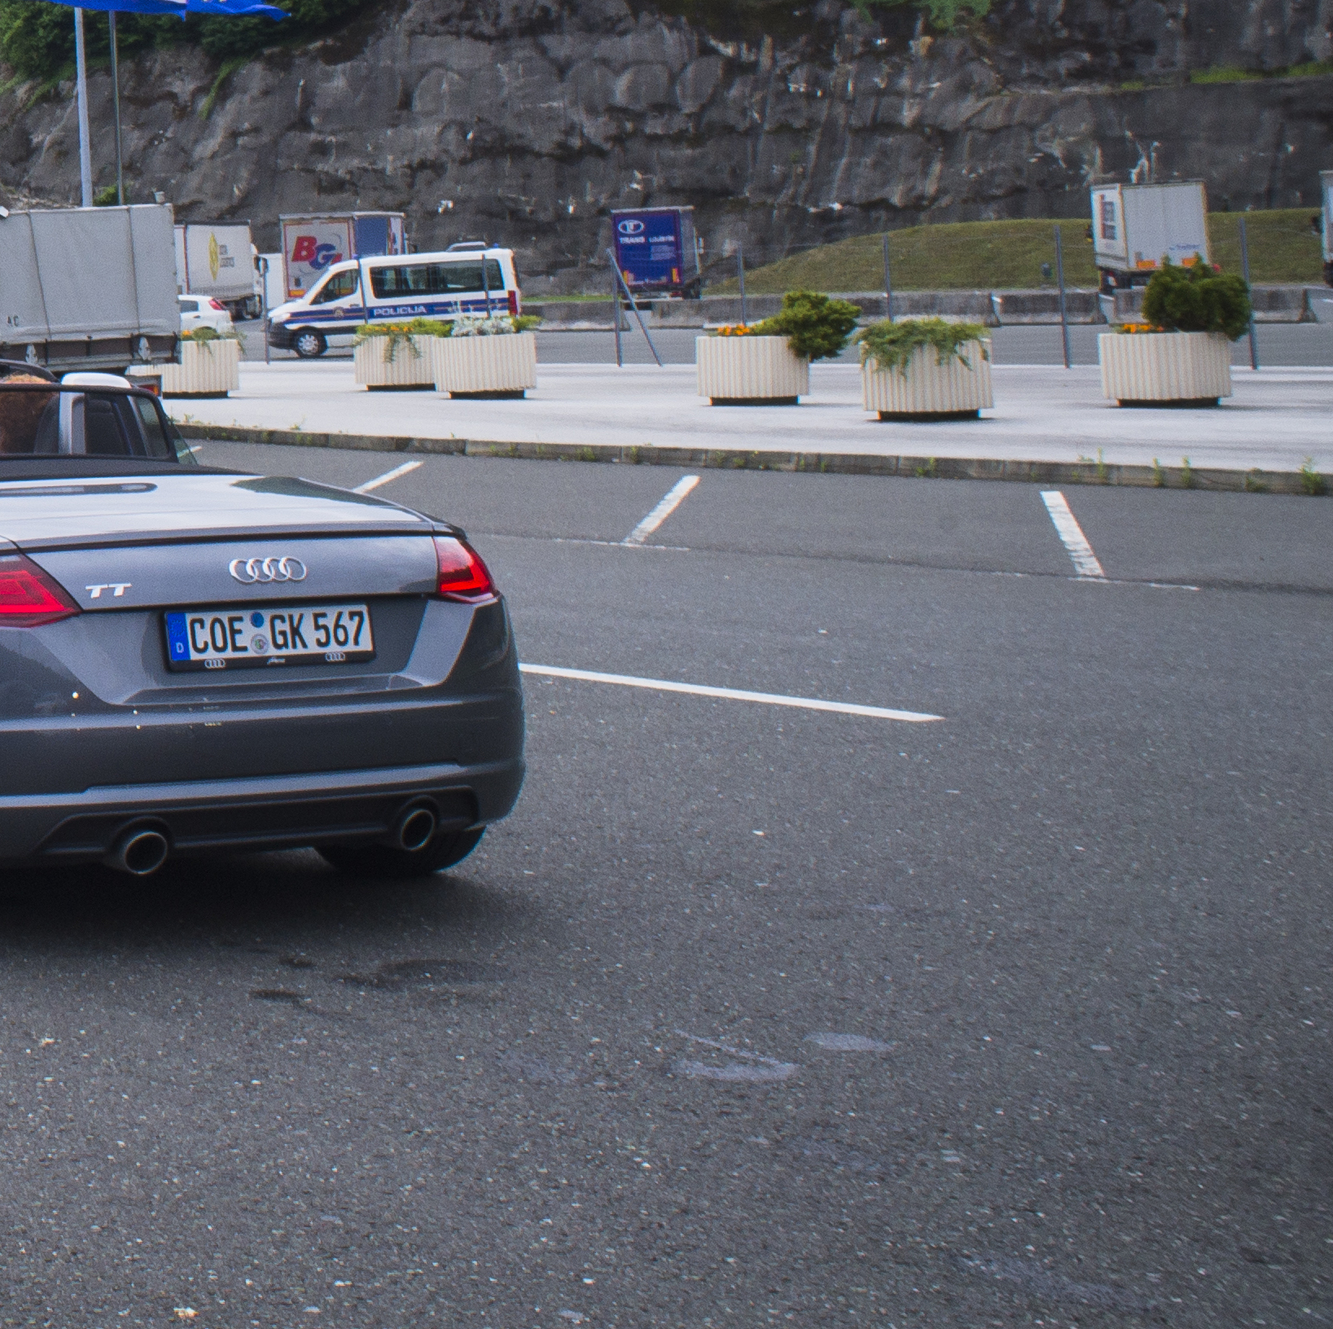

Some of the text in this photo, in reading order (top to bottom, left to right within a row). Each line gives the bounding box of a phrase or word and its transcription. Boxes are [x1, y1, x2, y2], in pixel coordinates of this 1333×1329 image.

[374, 305, 427, 316] POLICIJA
[86, 582, 132, 599] TT
[190, 610, 365, 653] COE GK 567
[176, 642, 183, 654] D
